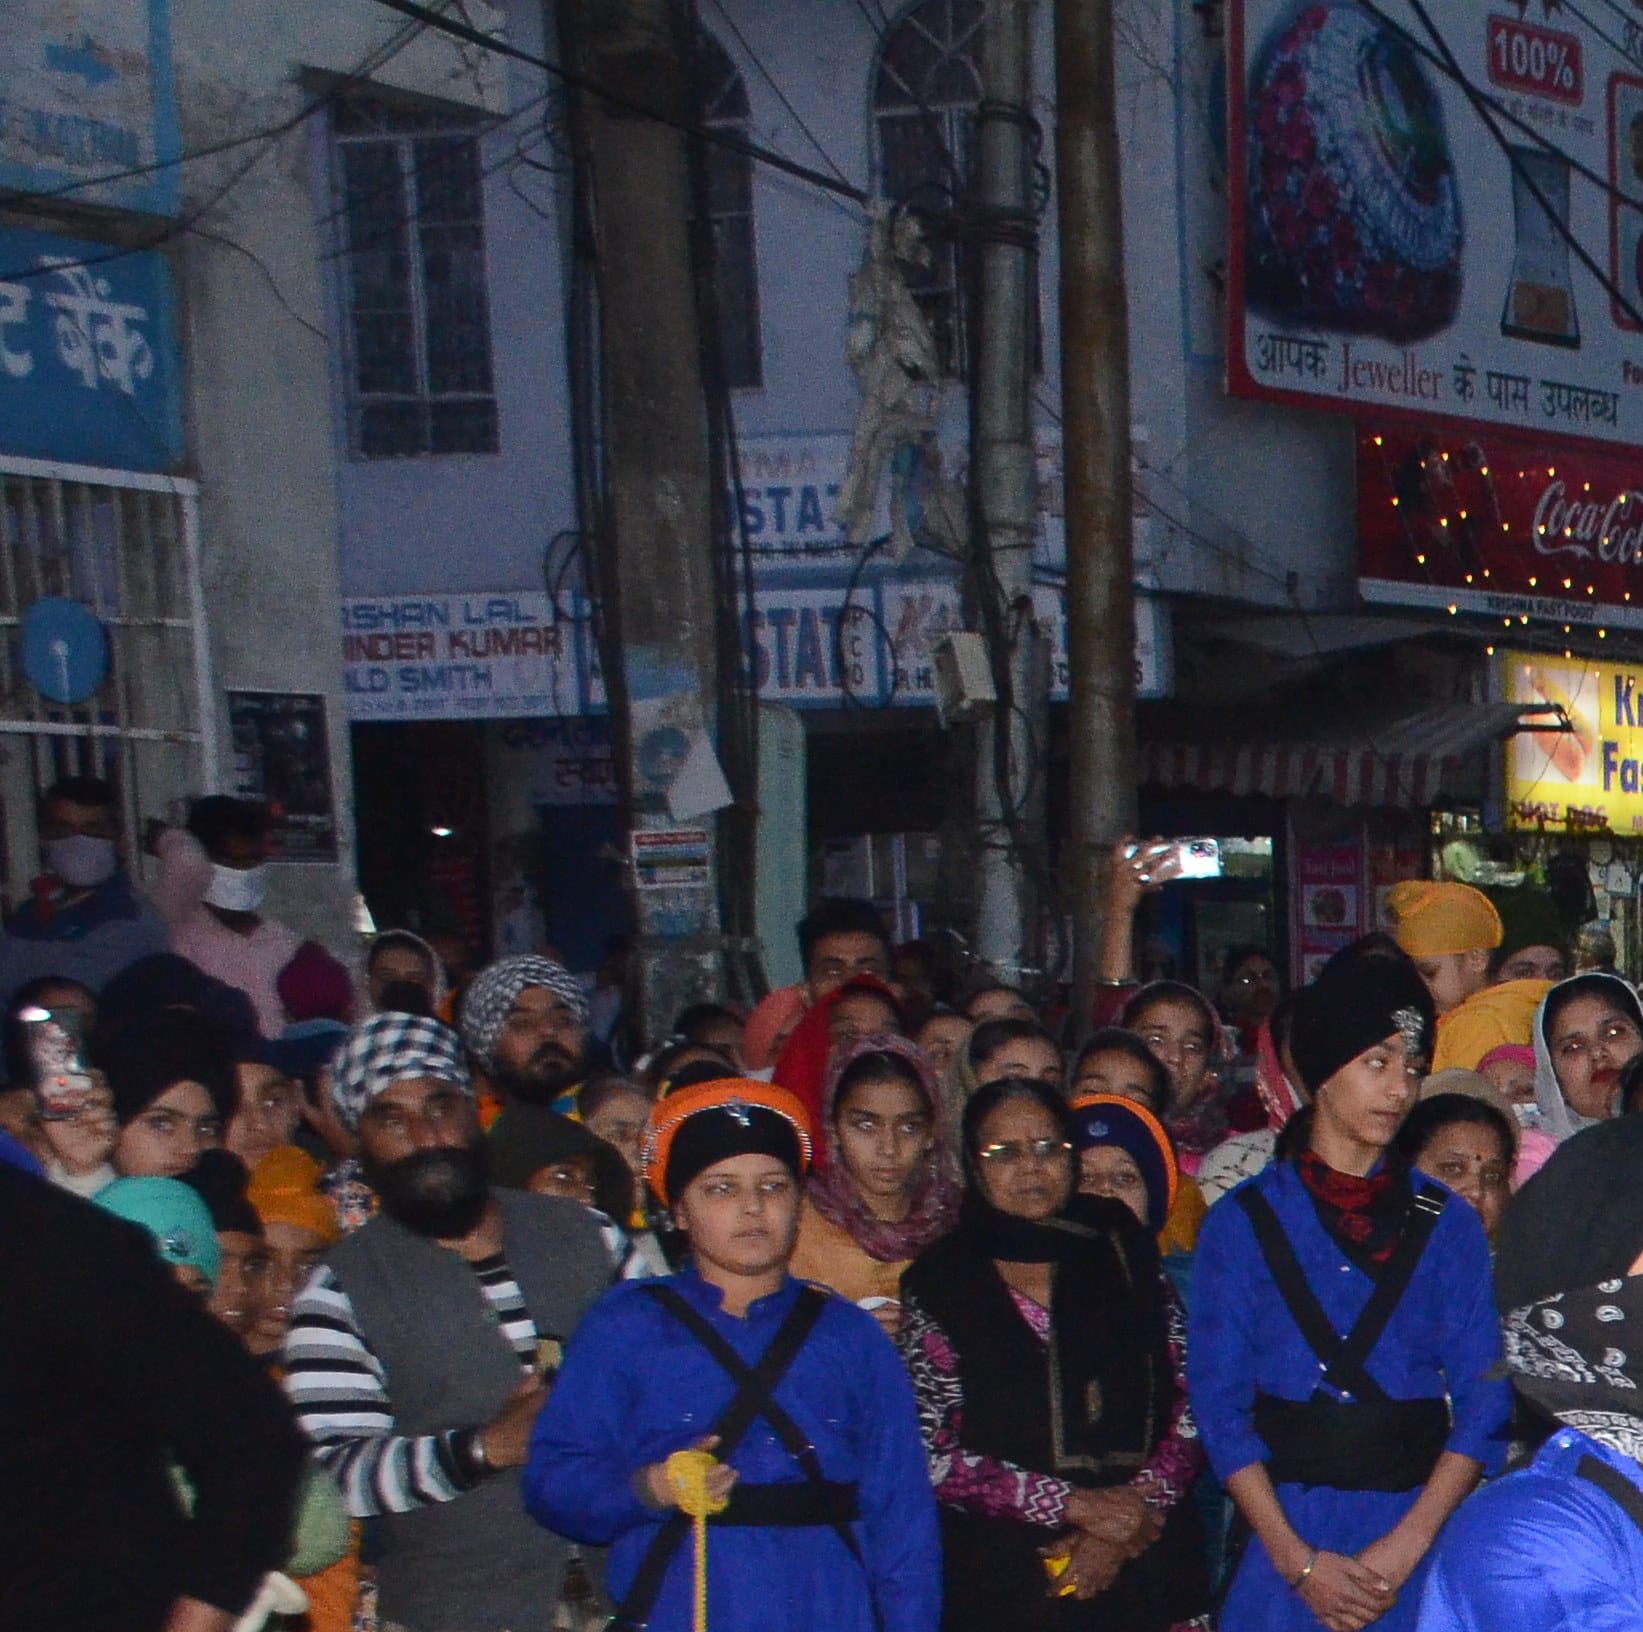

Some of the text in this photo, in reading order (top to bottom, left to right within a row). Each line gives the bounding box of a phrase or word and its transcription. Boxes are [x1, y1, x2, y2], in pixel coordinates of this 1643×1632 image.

[1494, 27, 1574, 89] 100%
[1336, 344, 1444, 401] Jeweller
[1453, 353, 1477, 402] के
[1486, 370, 1532, 413] पास
[464, 600, 536, 625] LAL
[449, 627, 561, 659] KUMAR
[400, 665, 491, 691] SMITH
